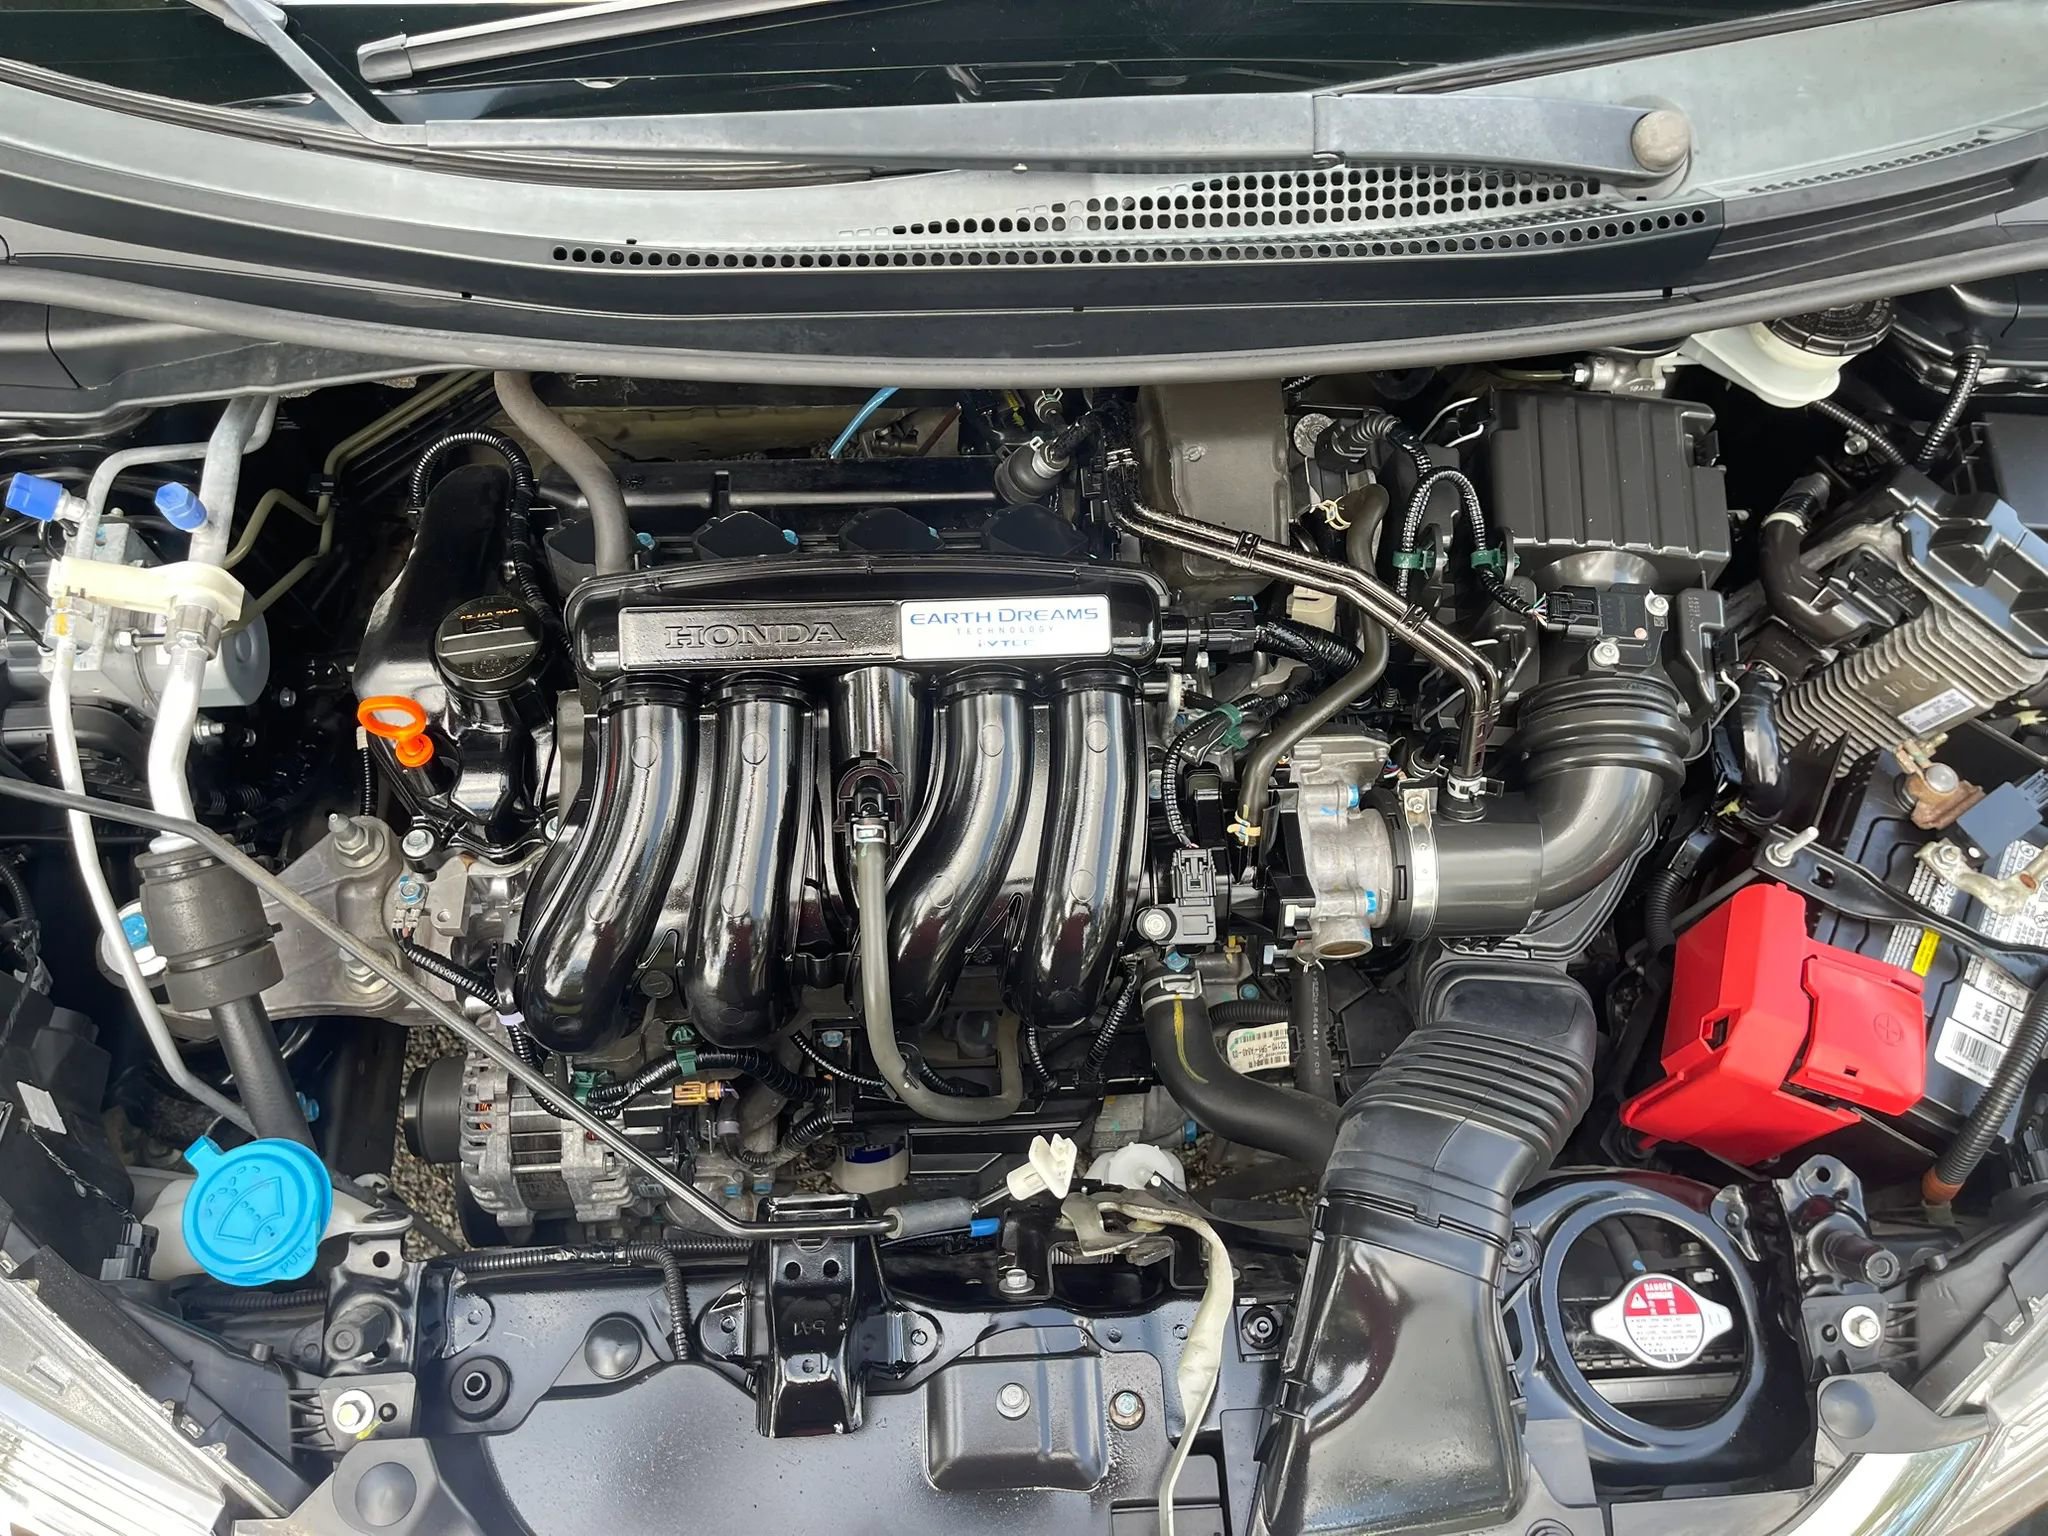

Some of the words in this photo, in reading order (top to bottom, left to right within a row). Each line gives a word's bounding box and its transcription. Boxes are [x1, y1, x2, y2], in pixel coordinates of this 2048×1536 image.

[910, 612, 991, 625] EARTH
[999, 608, 1098, 622] DREAMS
[665, 622, 847, 649] HONDA
[957, 625, 1054, 636] TECHNOLOGY
[279, 1245, 312, 1274] PULL
